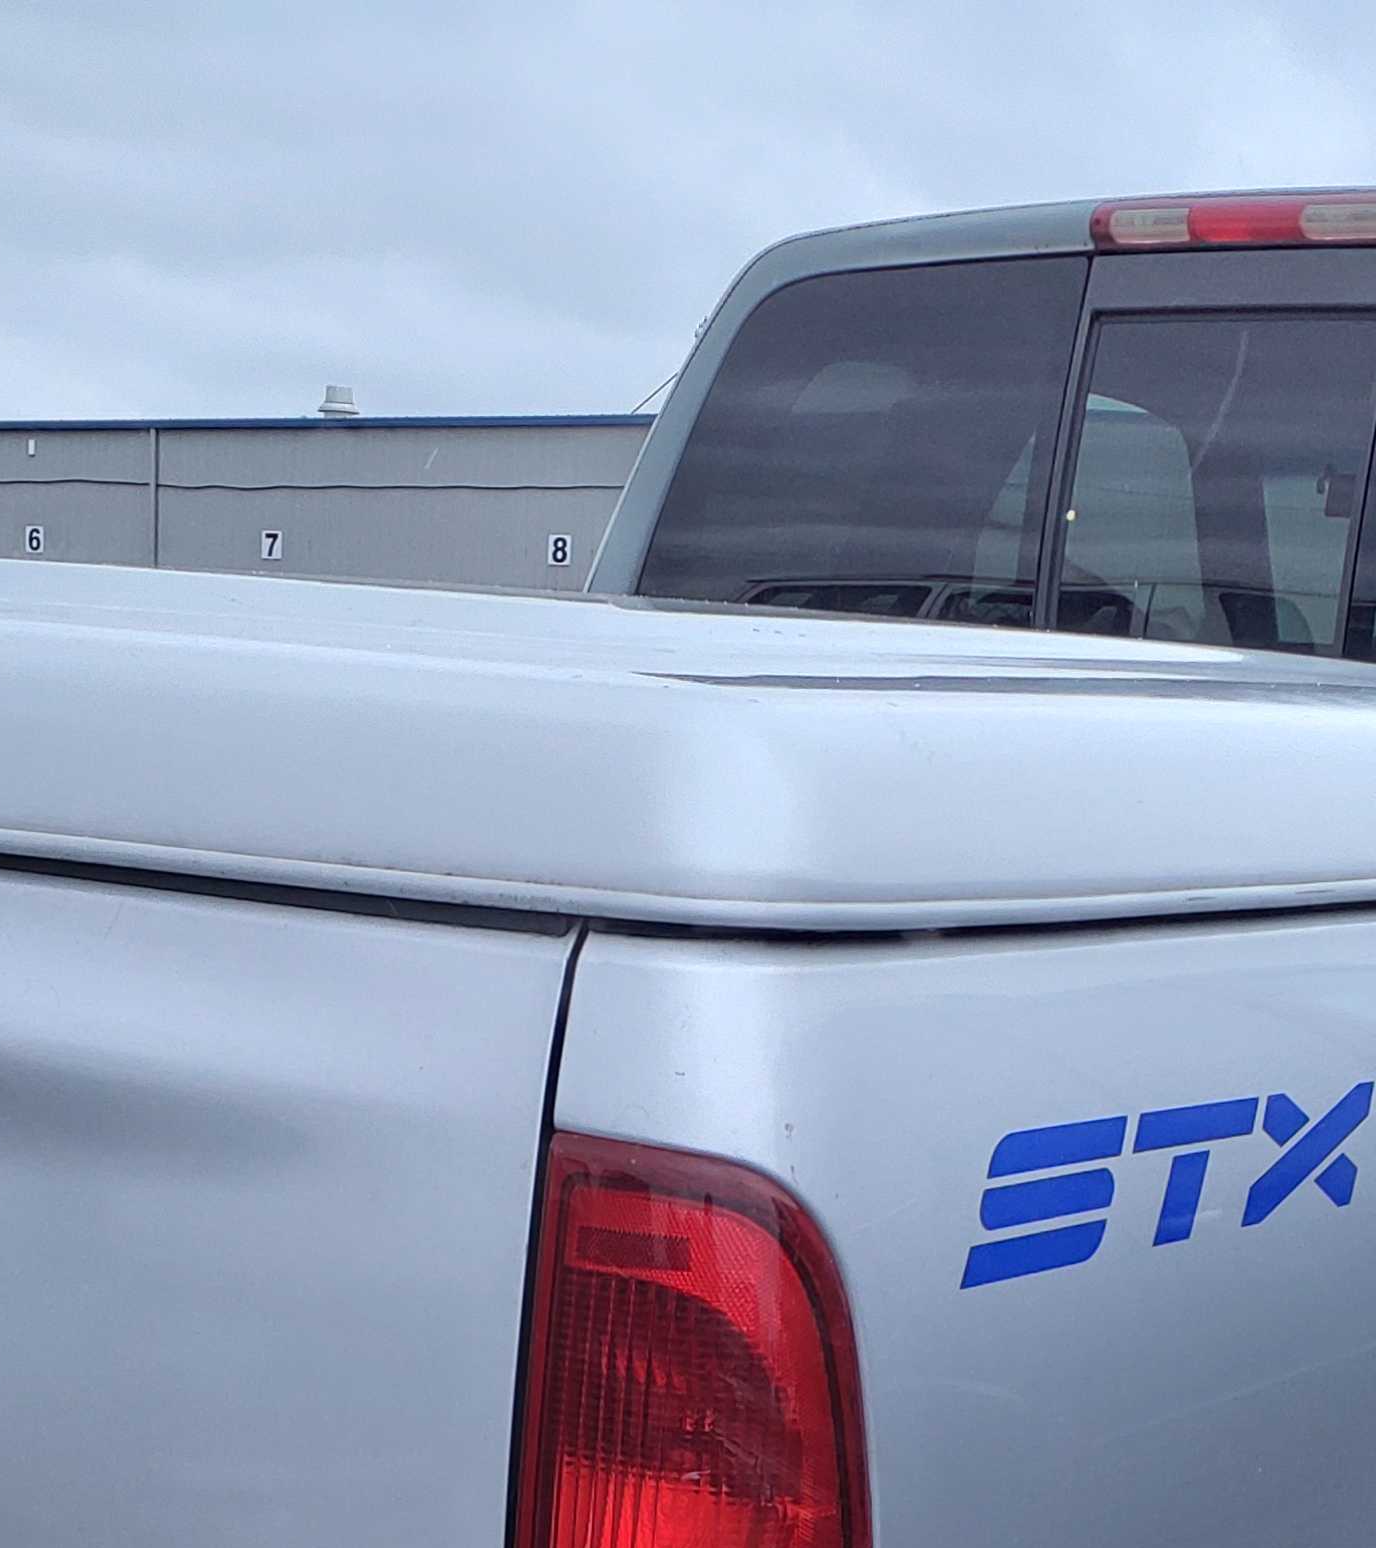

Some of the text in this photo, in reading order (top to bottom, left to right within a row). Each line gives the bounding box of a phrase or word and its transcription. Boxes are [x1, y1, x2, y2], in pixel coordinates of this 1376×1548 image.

[28, 527, 41, 551] 6
[264, 532, 280, 557] 7
[551, 536, 568, 563] 8
[960, 1081, 1375, 1289] STX
